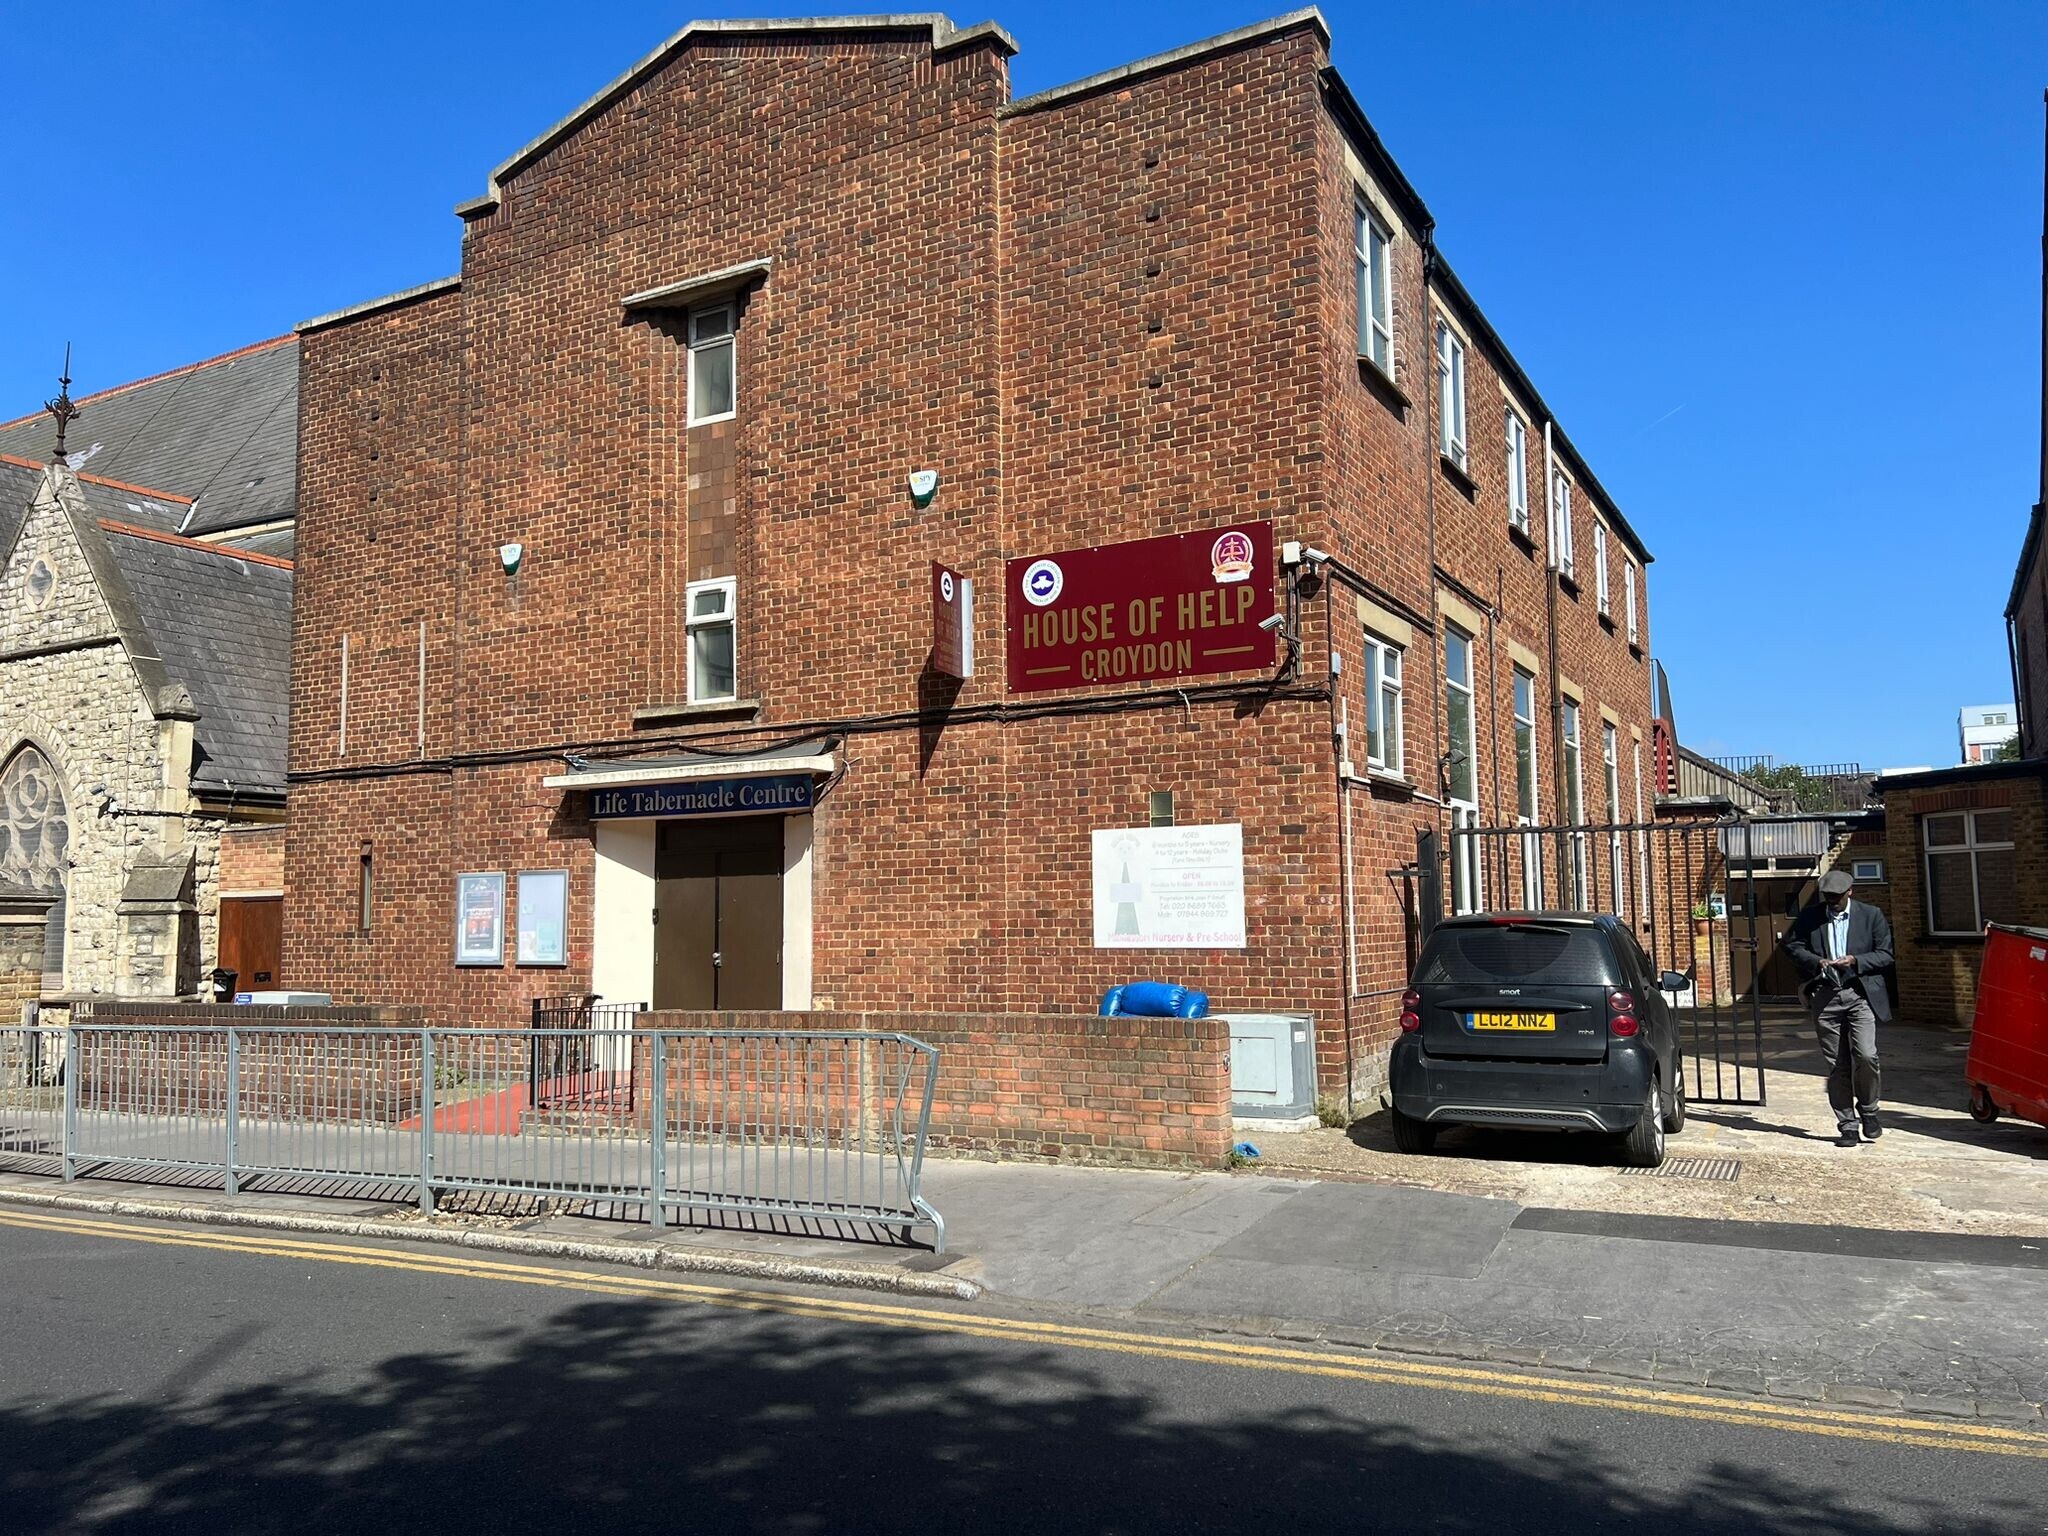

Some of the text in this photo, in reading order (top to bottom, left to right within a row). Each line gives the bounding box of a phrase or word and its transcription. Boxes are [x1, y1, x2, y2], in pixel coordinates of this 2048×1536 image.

[1023, 585, 1256, 649] HOUSE OF HELP
[1081, 639, 1193, 680] CROYDON
[593, 783, 806, 815] Life Tabernacle Centre
[1182, 872, 1201, 880] OPEN
[1171, 902, 1186, 910] 020
[1152, 932, 1184, 944] Nursery
[1186, 932, 1194, 942] &
[1499, 988, 1521, 996] smart
[1479, 1012, 1548, 1028] LC12 NNZ
